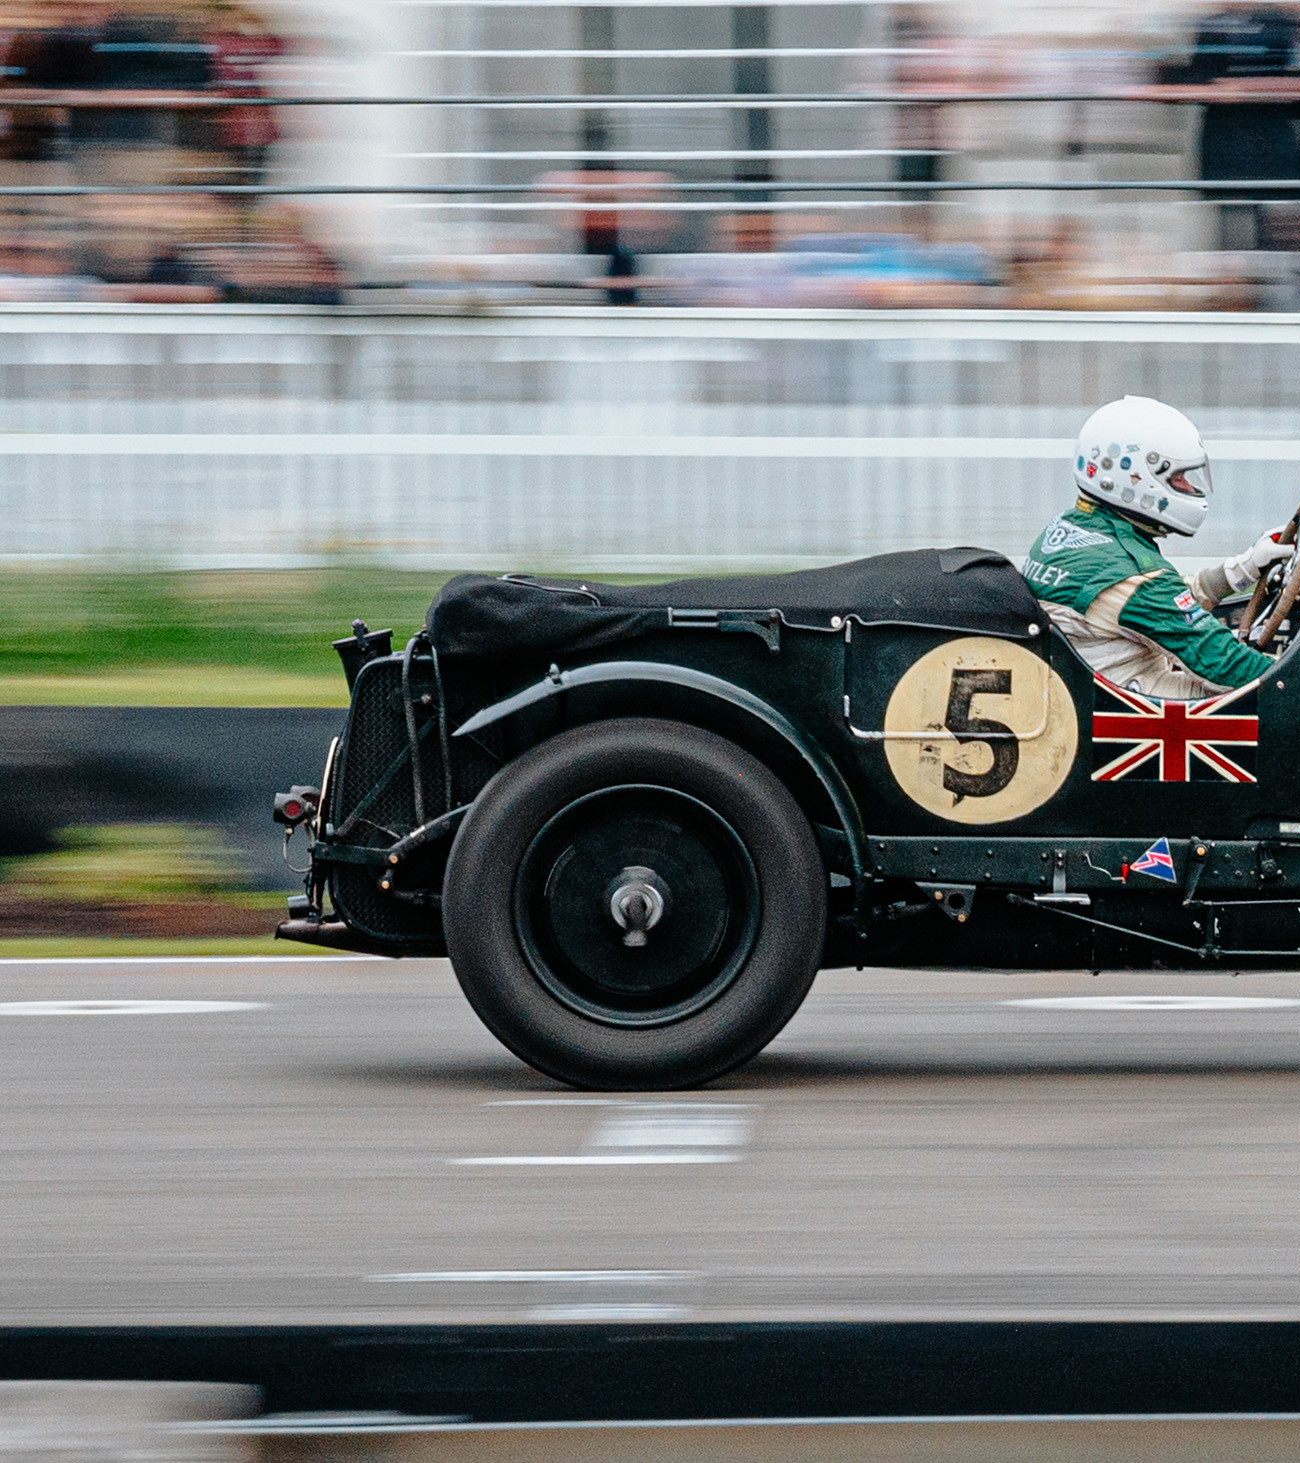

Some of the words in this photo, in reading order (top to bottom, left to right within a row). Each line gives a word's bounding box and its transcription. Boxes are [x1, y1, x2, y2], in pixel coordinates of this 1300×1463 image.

[1048, 527, 1067, 547] B
[1023, 559, 1070, 587] NTLEY
[943, 668, 1020, 799] 5
